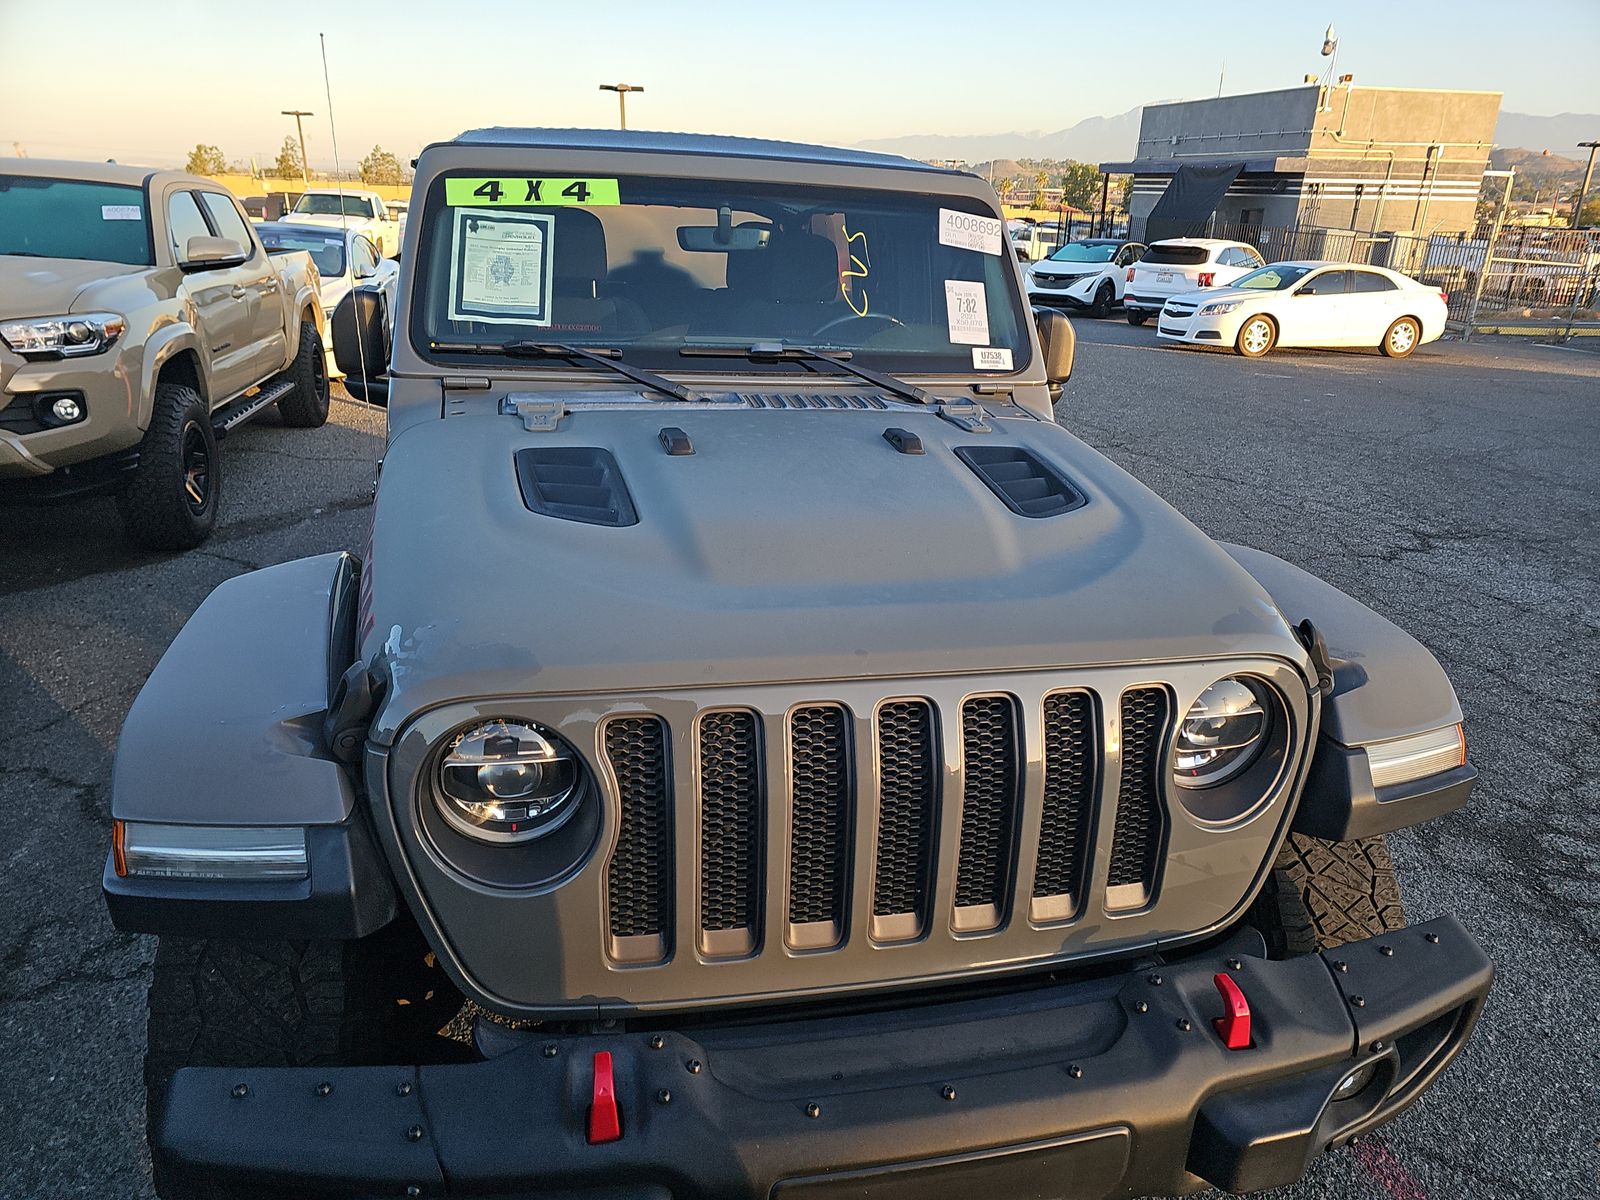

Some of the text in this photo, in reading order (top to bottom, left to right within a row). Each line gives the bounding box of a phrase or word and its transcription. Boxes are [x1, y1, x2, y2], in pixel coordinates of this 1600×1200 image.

[473, 180, 592, 202] 4 X 4
[946, 214, 1001, 237] 4008692
[957, 297, 977, 313] 7:82
[980, 351, 1002, 360] U7538
